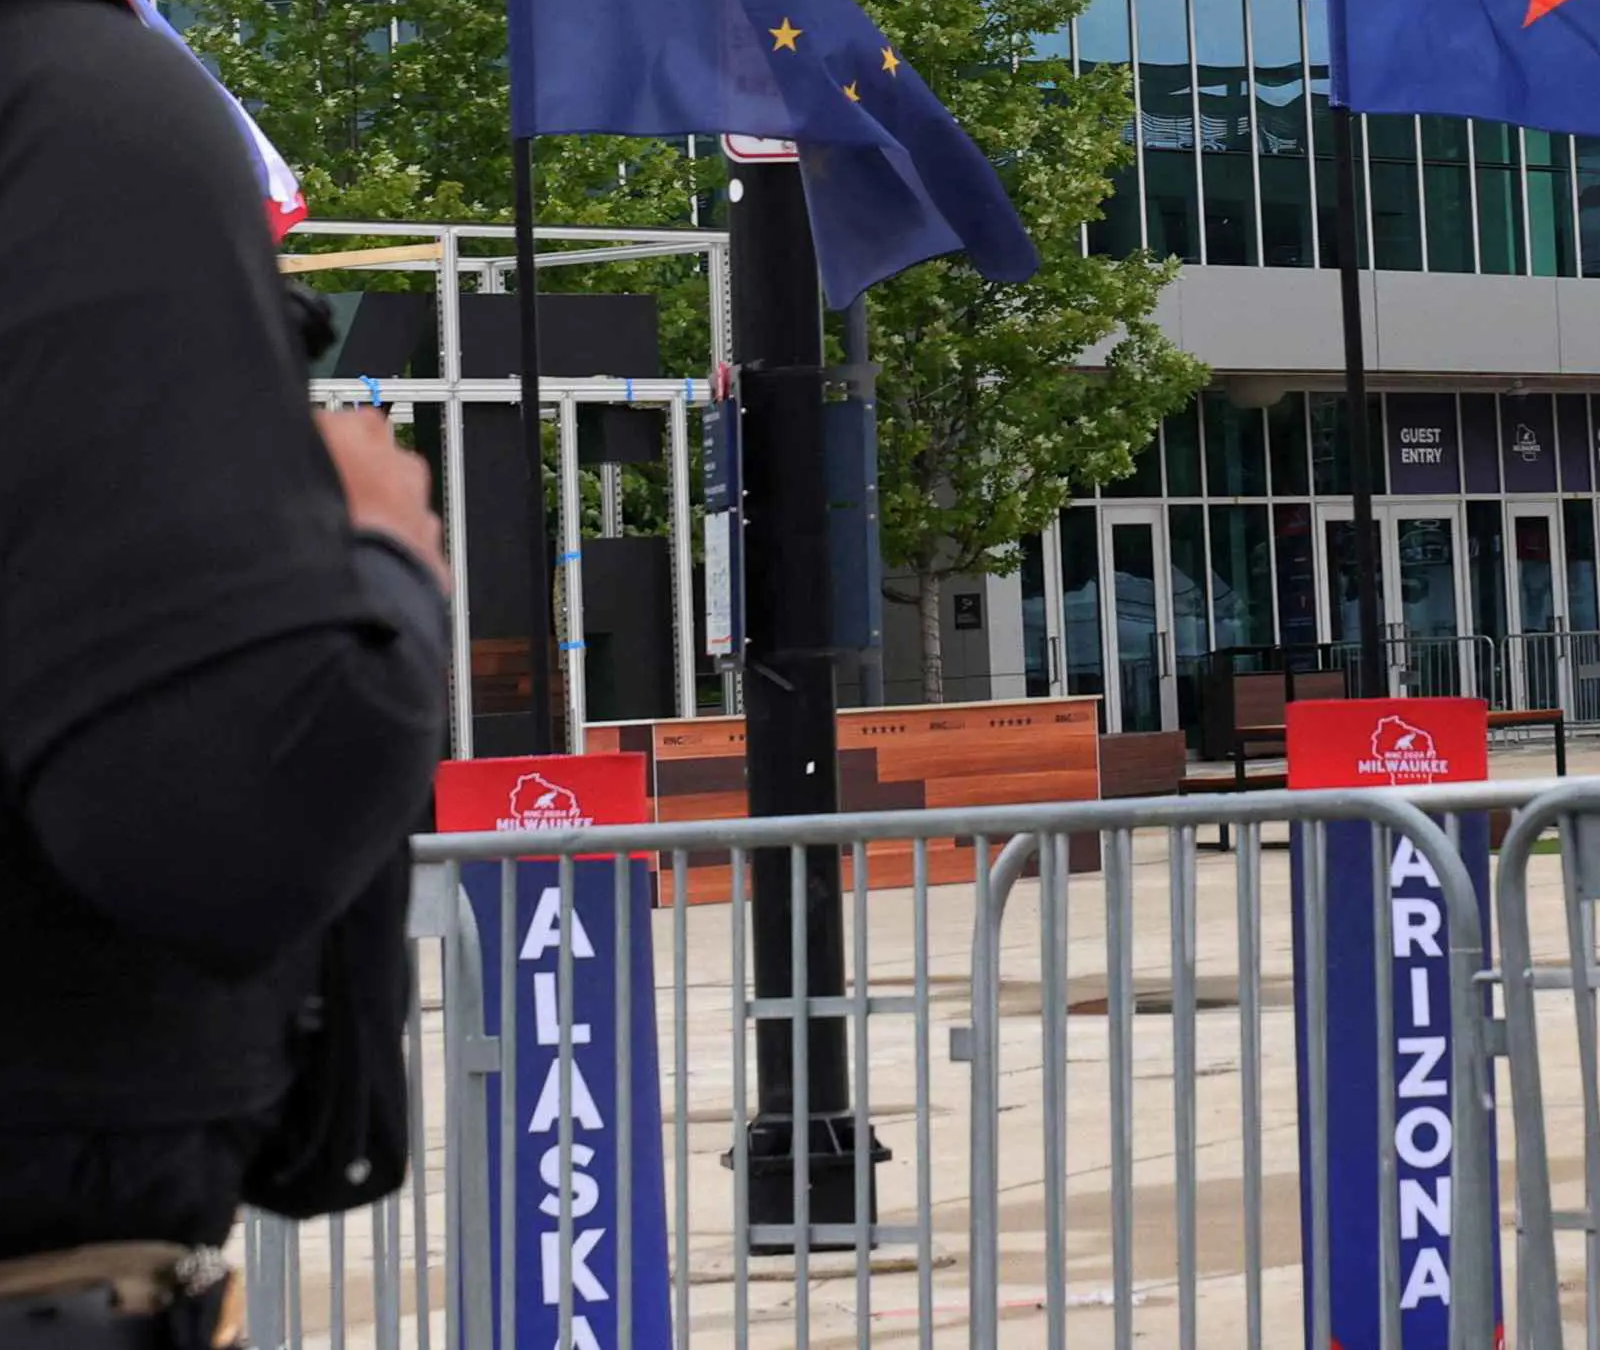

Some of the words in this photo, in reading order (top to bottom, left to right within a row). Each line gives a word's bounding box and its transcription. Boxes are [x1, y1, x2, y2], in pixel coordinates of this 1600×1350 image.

[1401, 428, 1441, 443] GUEST
[1402, 448, 1442, 463] ENTRY
[1358, 759, 1448, 773] MILWAUKEE
[1389, 834, 1453, 1309] ARIZONA
